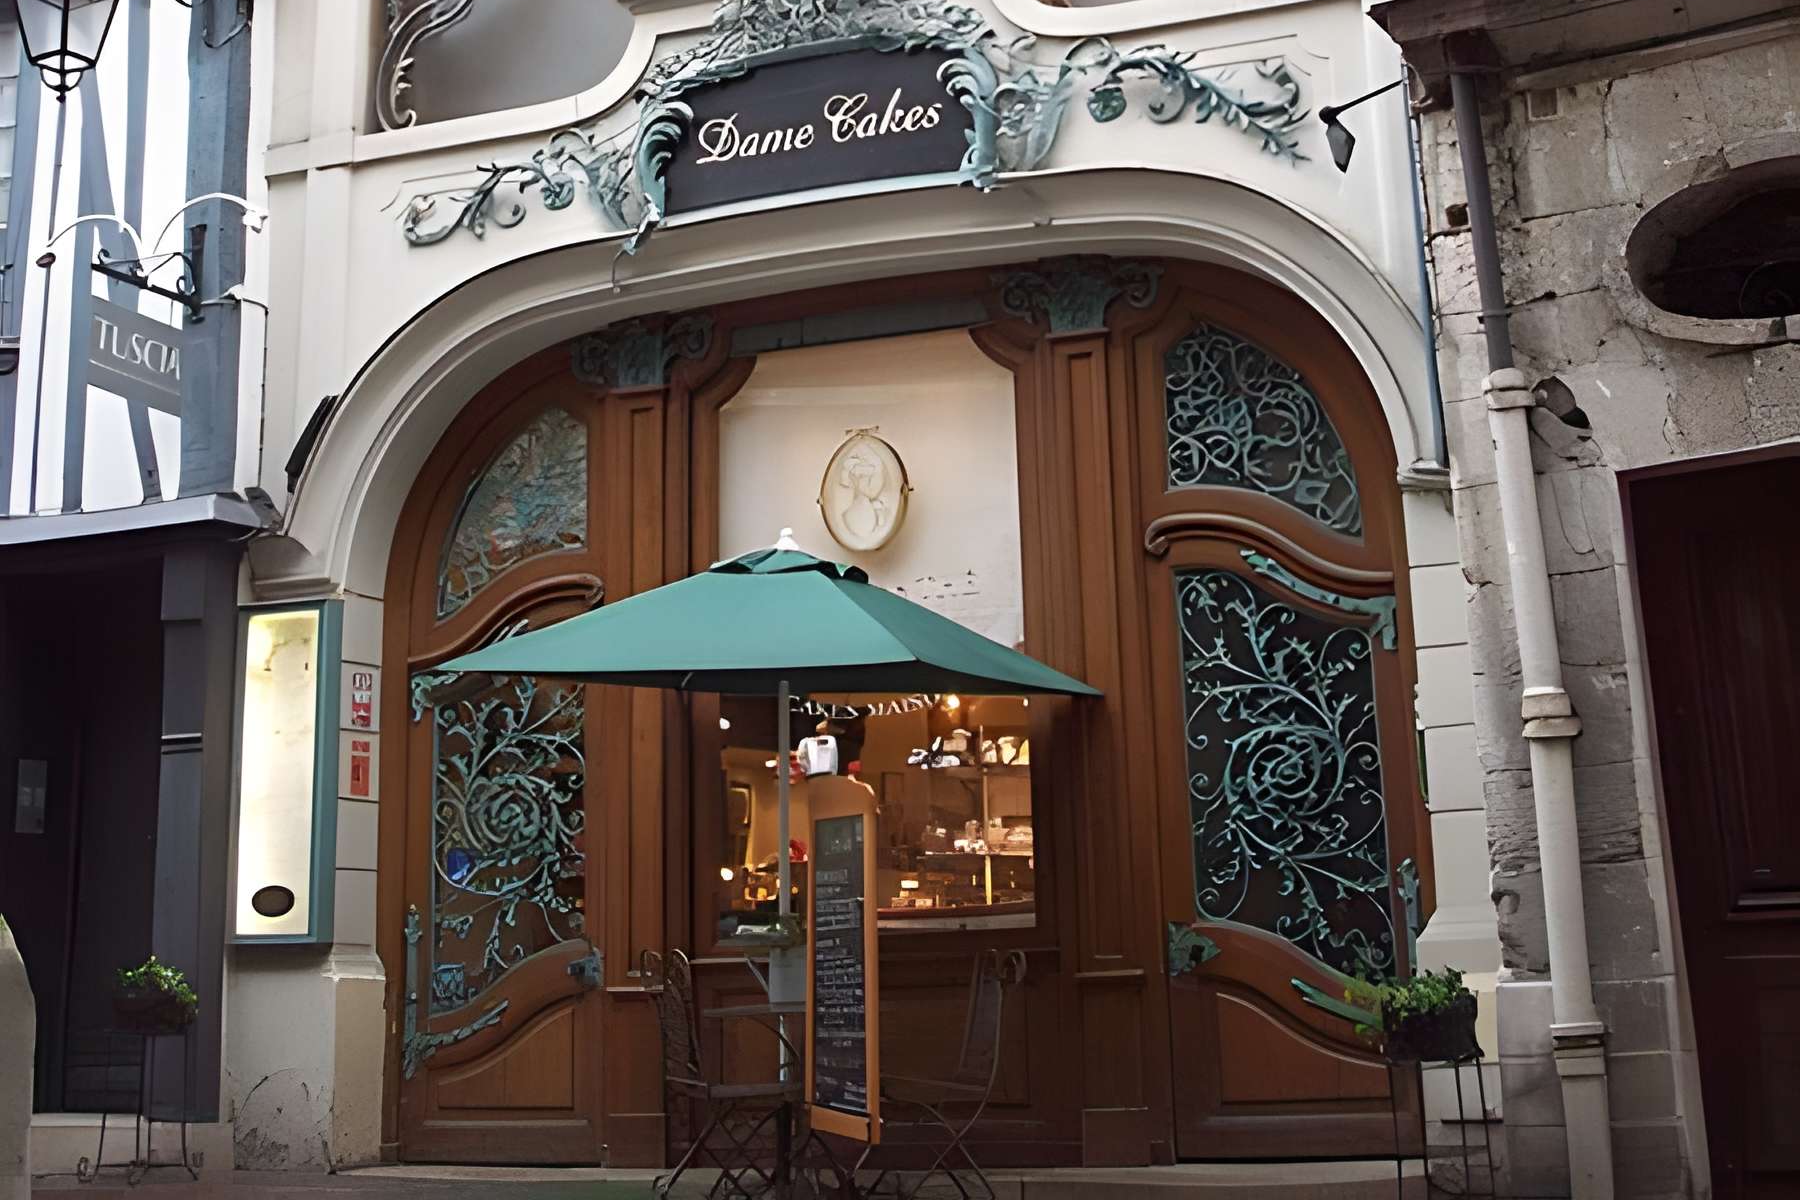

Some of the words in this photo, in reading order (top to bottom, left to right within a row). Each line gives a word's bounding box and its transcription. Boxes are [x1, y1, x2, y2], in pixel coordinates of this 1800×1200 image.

[695, 112, 815, 165] Dame
[823, 87, 944, 143] Cakes
[93, 313, 181, 382] TUSCIA
